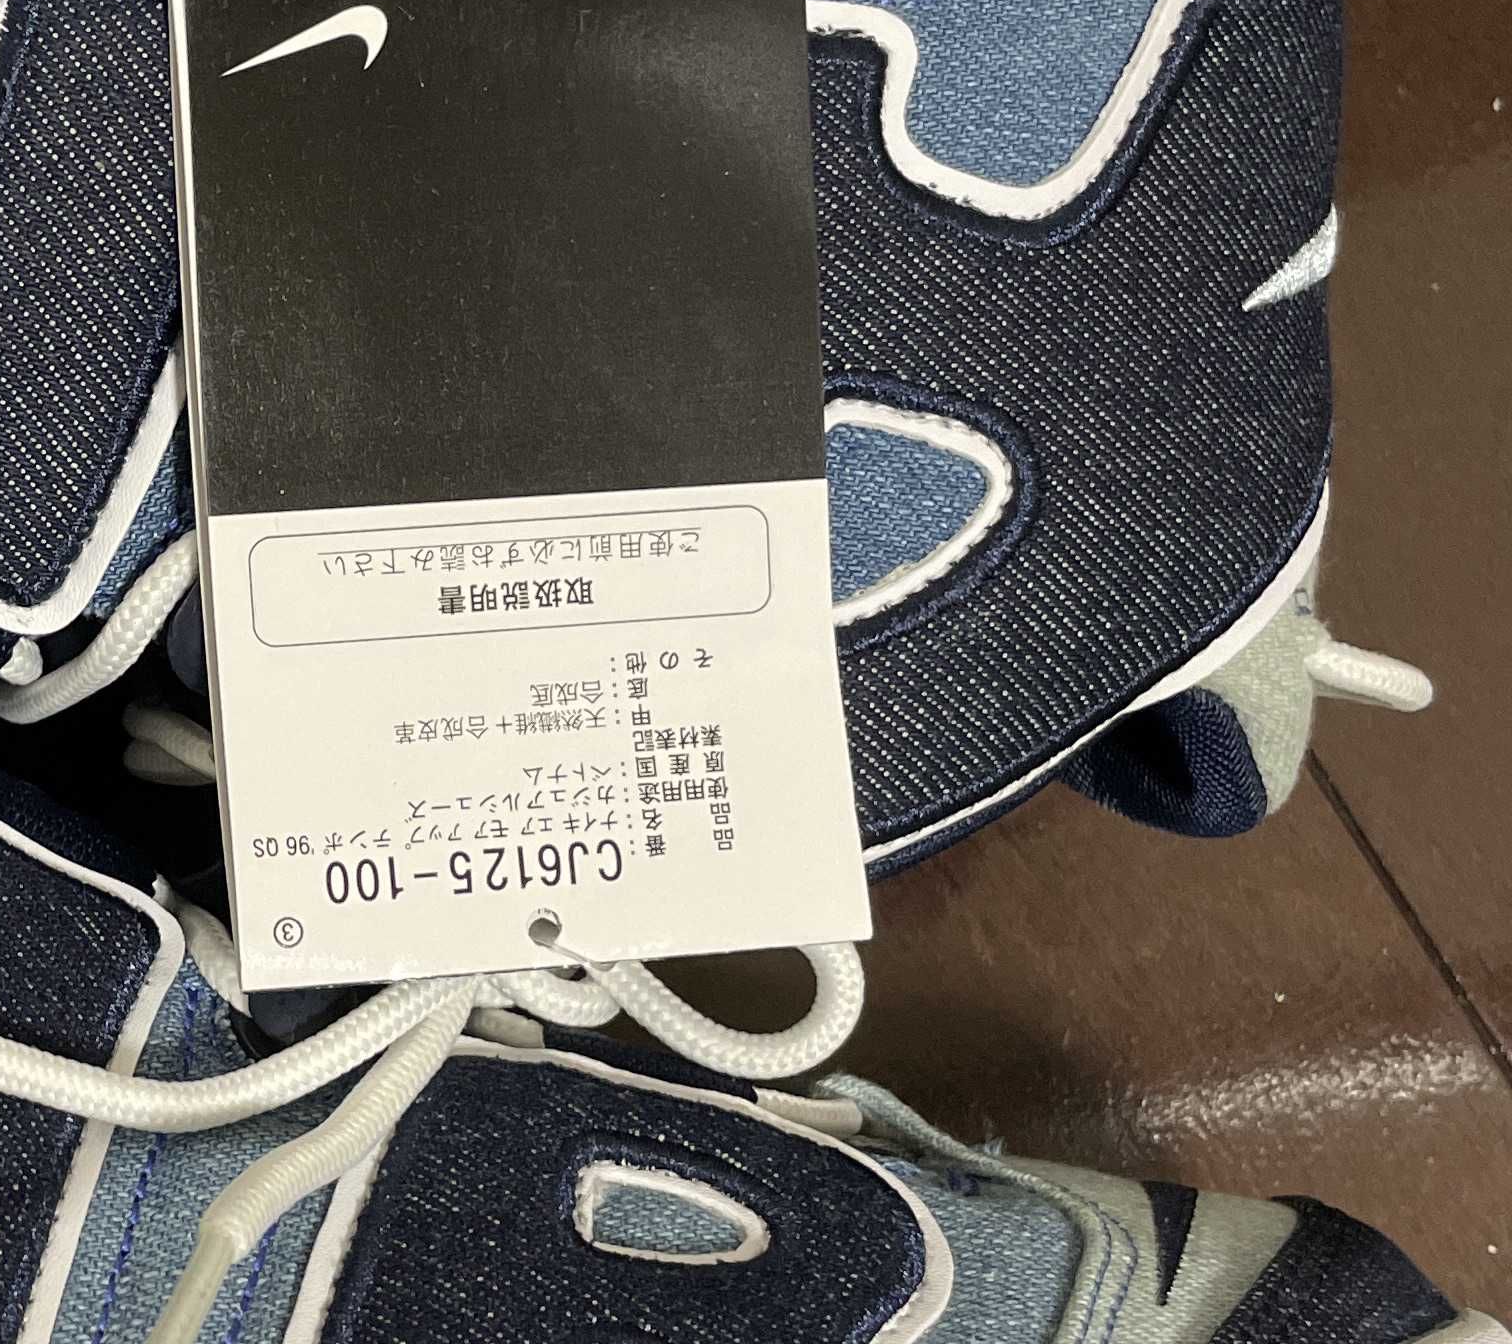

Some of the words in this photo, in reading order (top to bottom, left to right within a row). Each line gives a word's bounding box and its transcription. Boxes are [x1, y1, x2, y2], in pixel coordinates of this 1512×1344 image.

[321, 532, 701, 576] ご使用前に必ずお読み下さい
[438, 577, 594, 615] 取扱説明書
[633, 725, 721, 752] 素材表記
[326, 839, 622, 904] CJ6125-100
